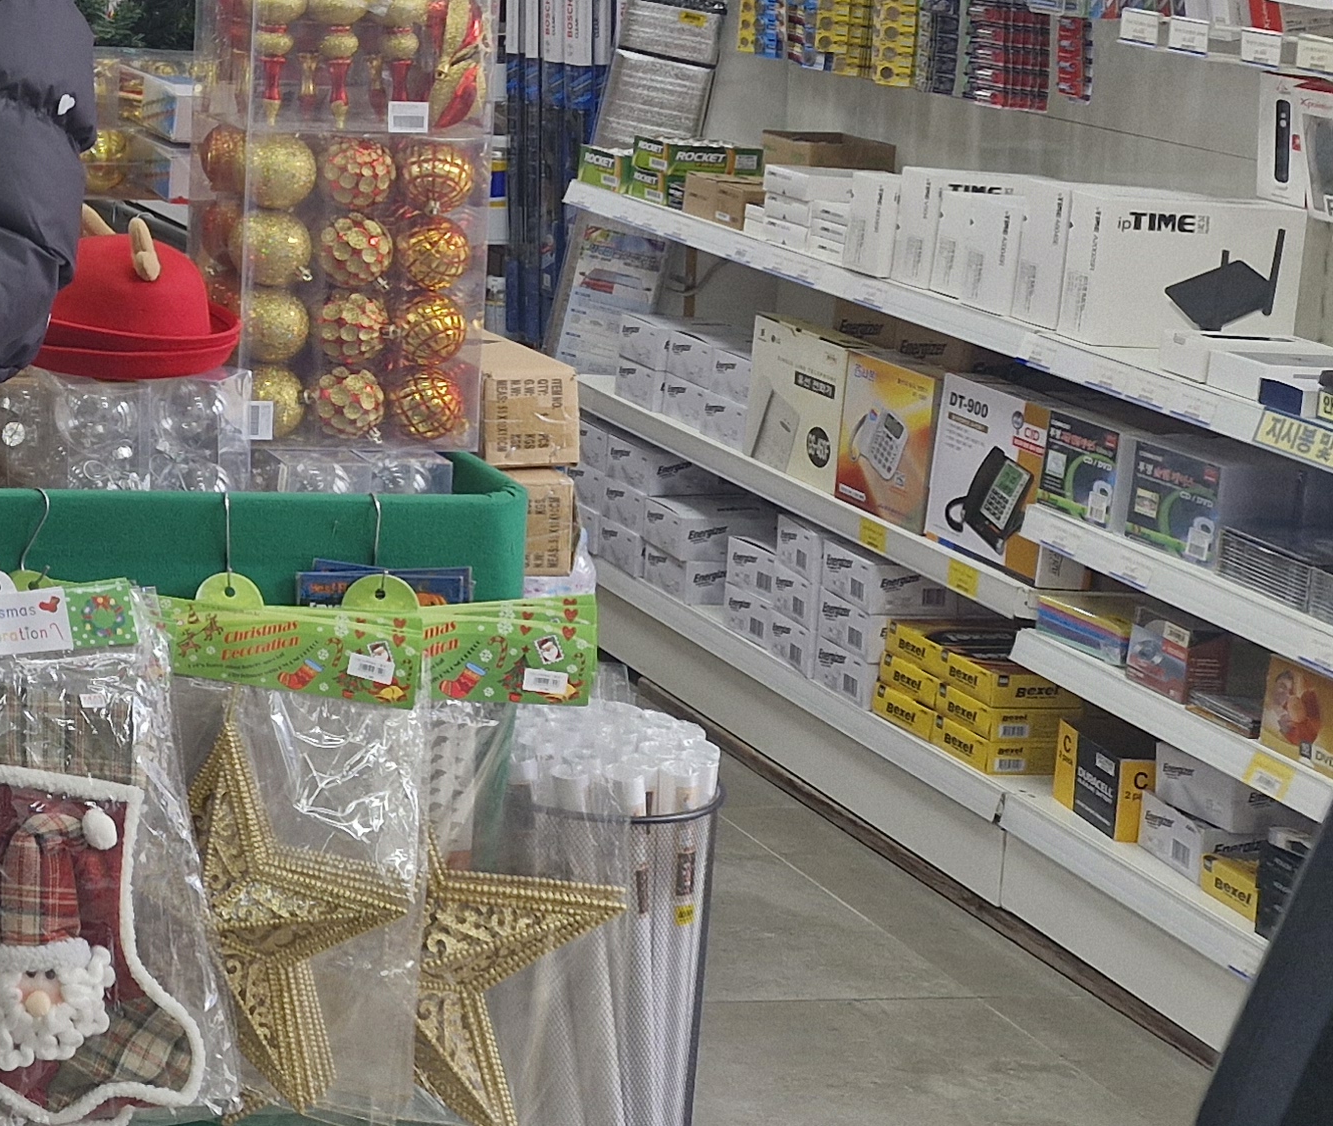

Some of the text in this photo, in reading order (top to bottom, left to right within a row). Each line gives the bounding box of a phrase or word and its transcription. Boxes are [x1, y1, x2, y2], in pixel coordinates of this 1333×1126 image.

[637, 140, 664, 155] ROCKET
[675, 150, 727, 164] ROCKET
[584, 152, 616, 168] ROCKET
[633, 172, 658, 186] ROCKET
[1117, 211, 1196, 234] ipTIME
[949, 391, 989, 419] DT-900
[1265, 416, 1318, 454] 지시봉
[688, 525, 728, 542] Energizer
[826, 554, 854, 569] Energizer
[822, 601, 851, 618] Energizer
[223, 619, 299, 645] Christmas
[220, 635, 300, 661] Decoration
[818, 648, 847, 665] Energizer
[898, 638, 927, 659] Bexel
[892, 670, 923, 691] Bexel
[948, 665, 978, 687] Bexel
[1015, 686, 1059, 699] Bexel
[886, 701, 916, 723] Bexel
[947, 701, 978, 723] Bexel
[944, 732, 974, 755] Bexel
[1063, 733, 1072, 754] C
[1077, 765, 1114, 799] DURACELL
[1133, 771, 1149, 791] C
[1145, 809, 1176, 828] Energizer
[1213, 877, 1253, 906] Bexel
